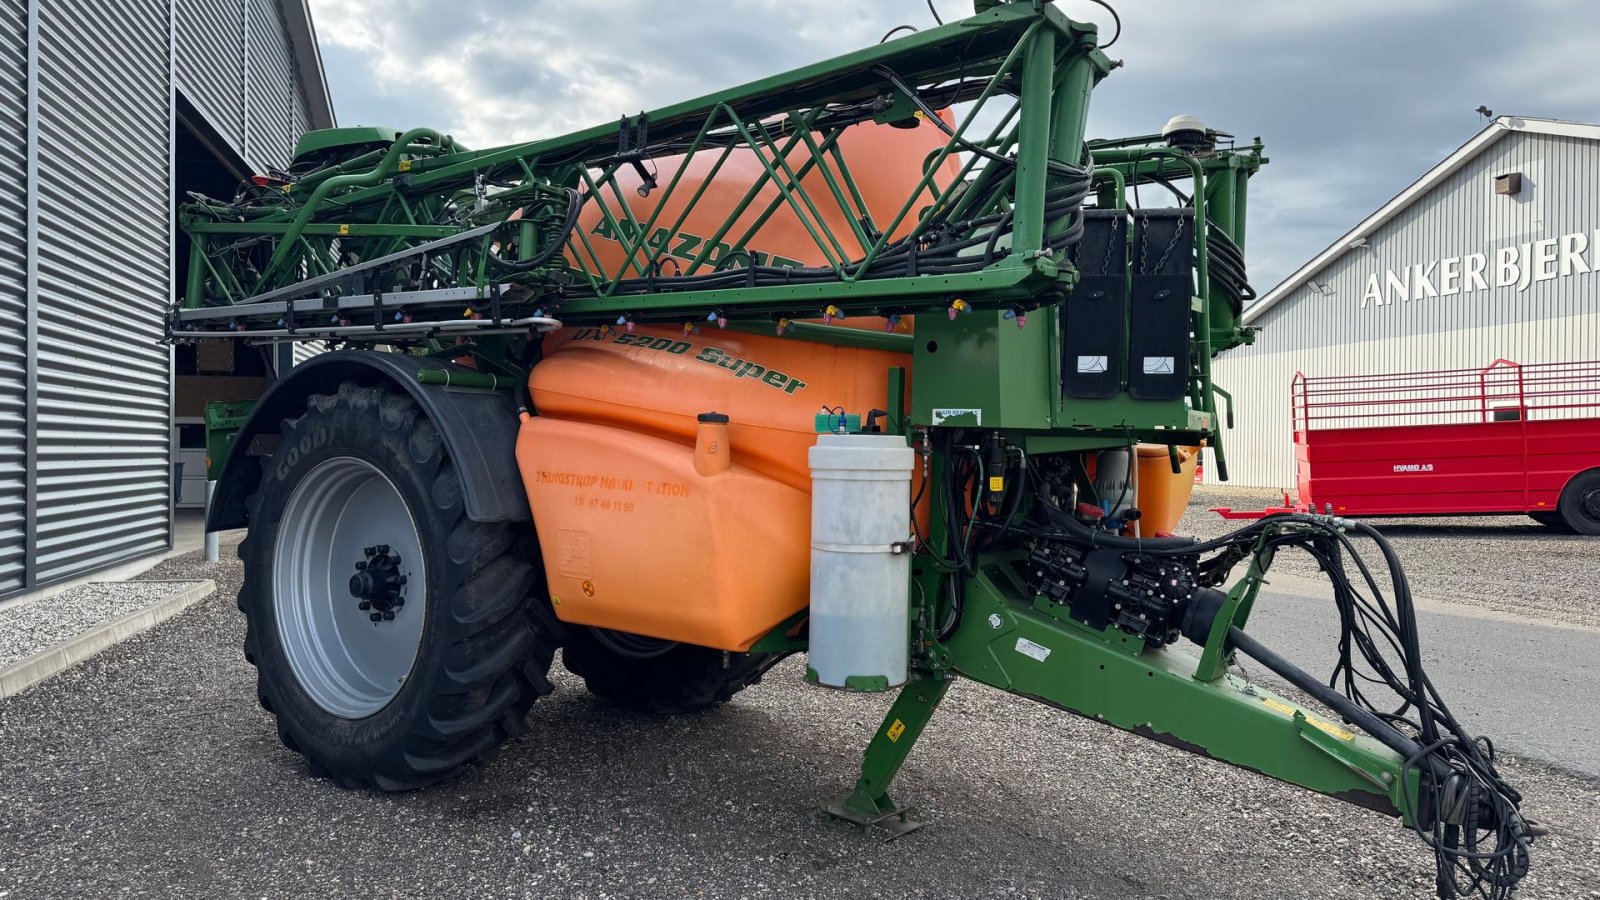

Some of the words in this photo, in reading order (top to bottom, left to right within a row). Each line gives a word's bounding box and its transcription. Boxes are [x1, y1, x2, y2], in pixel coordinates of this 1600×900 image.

[1361, 253, 1490, 309] ANKER
[613, 333, 693, 356] 5200
[694, 346, 808, 395] Super
[588, 497, 599, 509] 97
[600, 499, 611, 510] 48
[623, 502, 635, 513] 99
